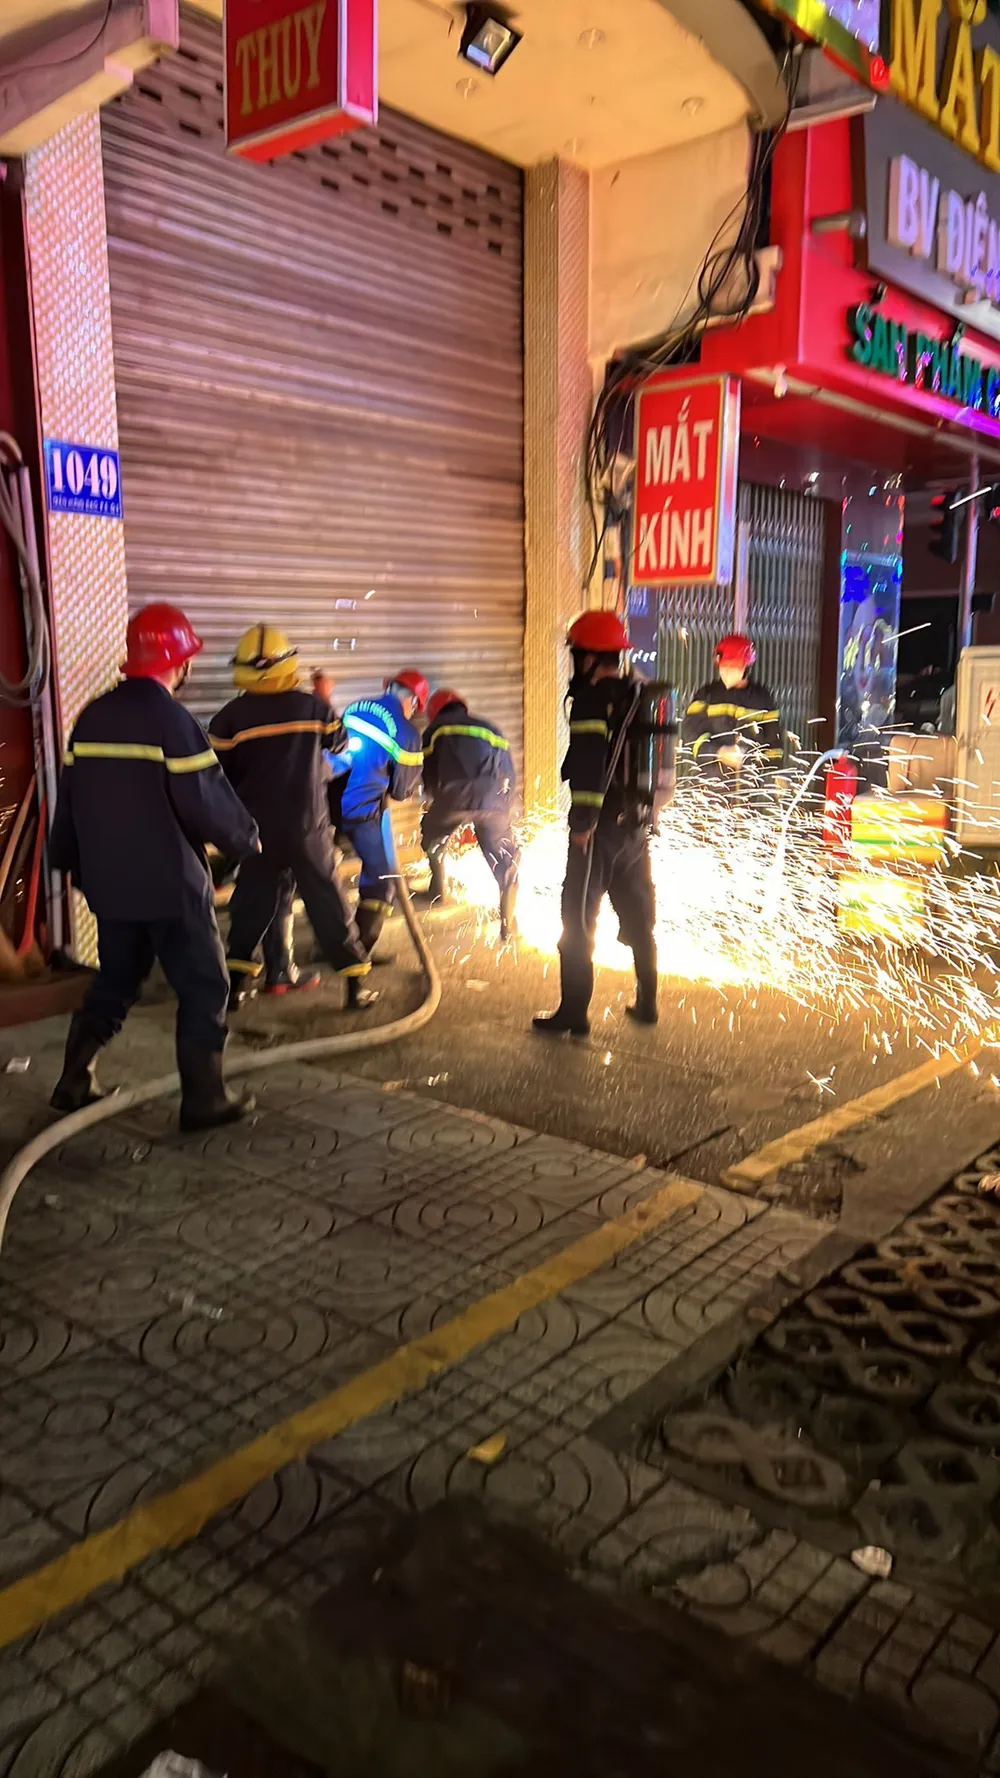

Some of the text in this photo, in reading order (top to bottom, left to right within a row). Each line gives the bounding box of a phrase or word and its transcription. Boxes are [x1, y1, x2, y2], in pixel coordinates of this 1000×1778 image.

[893, 154, 940, 259] BV
[52, 447, 117, 500] 1049
[644, 395, 714, 487] MẮT
[638, 496, 713, 571] KÍNH
